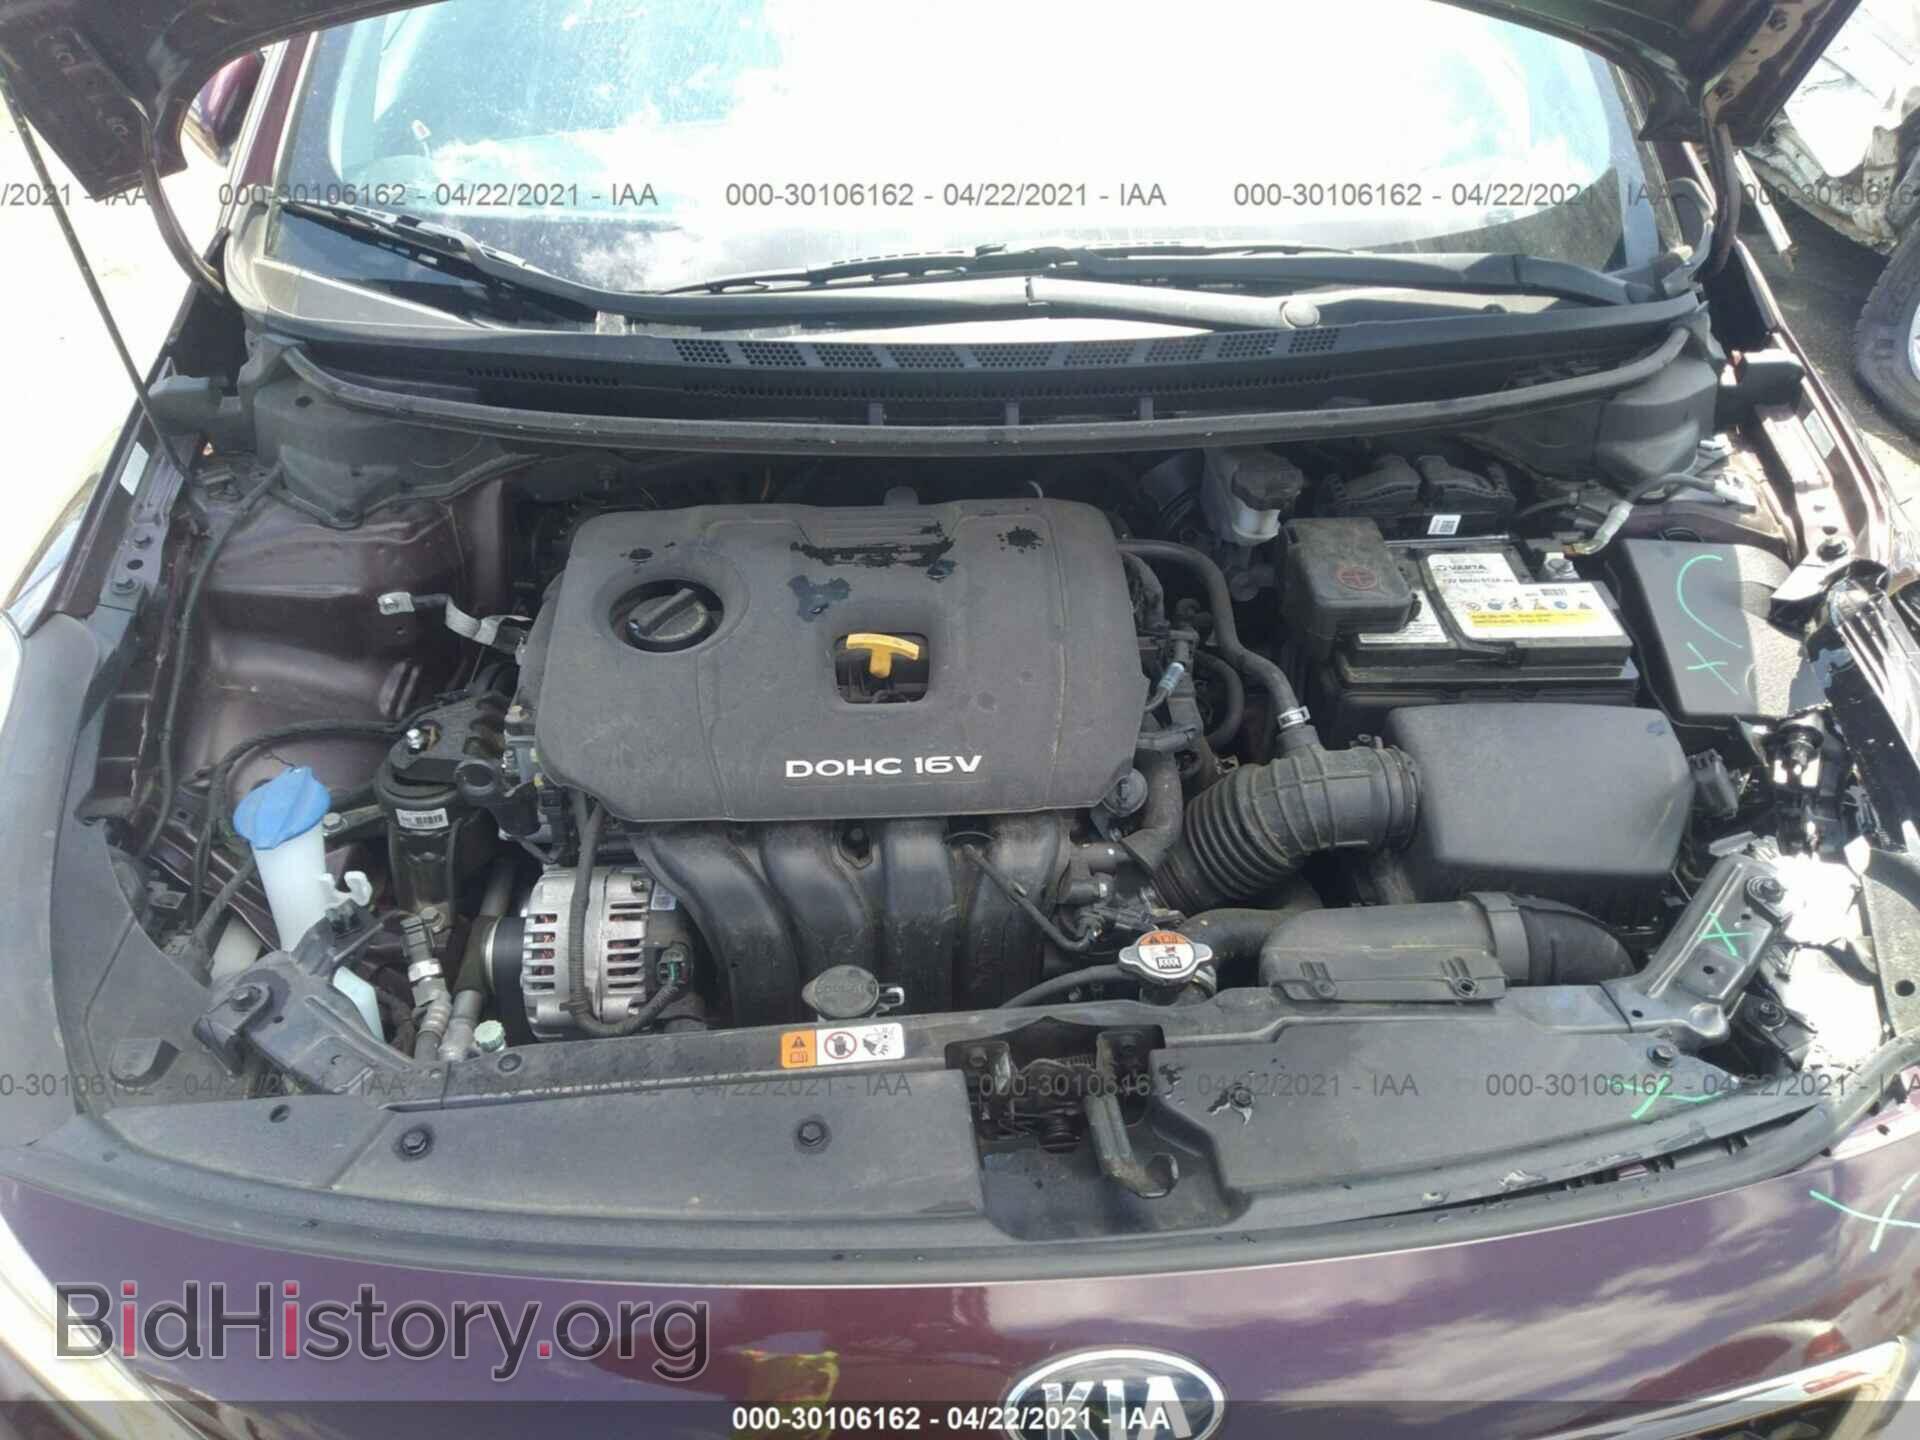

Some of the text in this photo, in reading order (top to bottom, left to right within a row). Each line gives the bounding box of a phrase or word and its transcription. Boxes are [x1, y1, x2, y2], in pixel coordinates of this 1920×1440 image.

[785, 755, 983, 778] DOHC 16V
[1041, 1376, 1193, 1440] KIA
